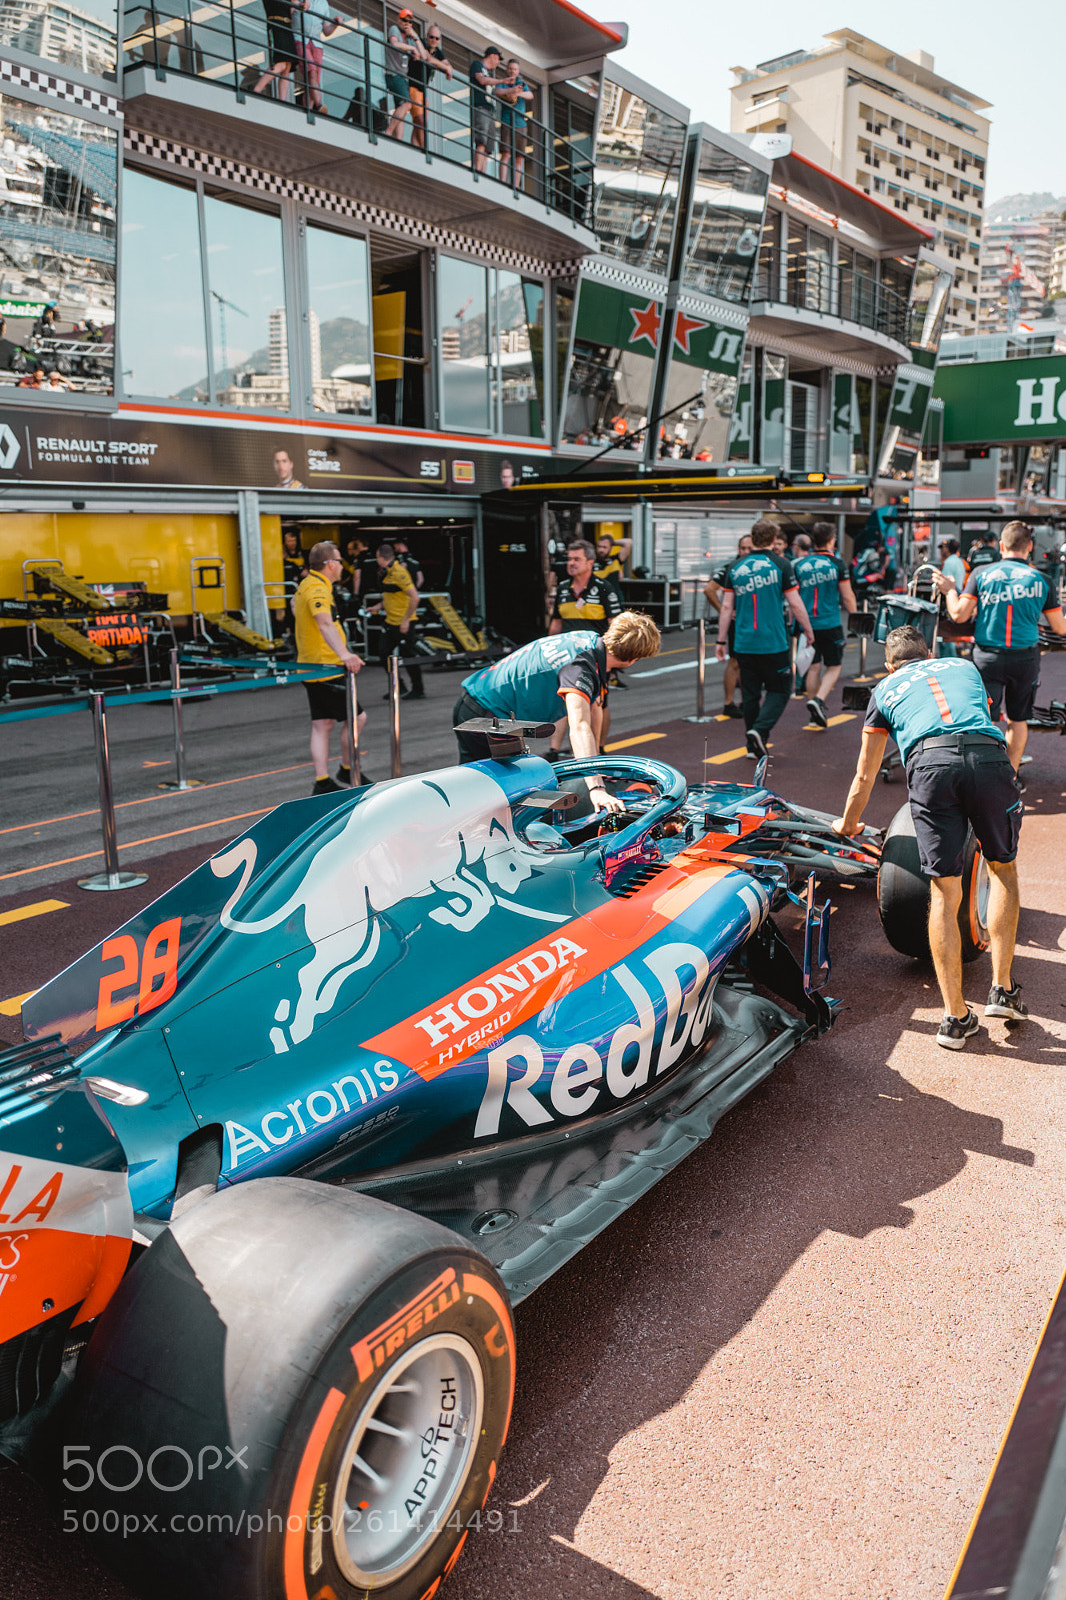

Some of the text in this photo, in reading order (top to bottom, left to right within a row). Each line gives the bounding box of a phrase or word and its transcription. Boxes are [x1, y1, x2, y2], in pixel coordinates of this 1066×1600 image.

[1014, 376, 1066, 426] H
[36, 437, 158, 455] RENAULT SPORT
[38, 452, 150, 466] FORMULA ONE TEAM
[95, 916, 182, 1032] 28
[414, 937, 588, 1047] HONDA
[438, 1010, 512, 1065] HYBRID
[225, 1059, 399, 1169] Acronis
[350, 1267, 461, 1383] PIRELLI
